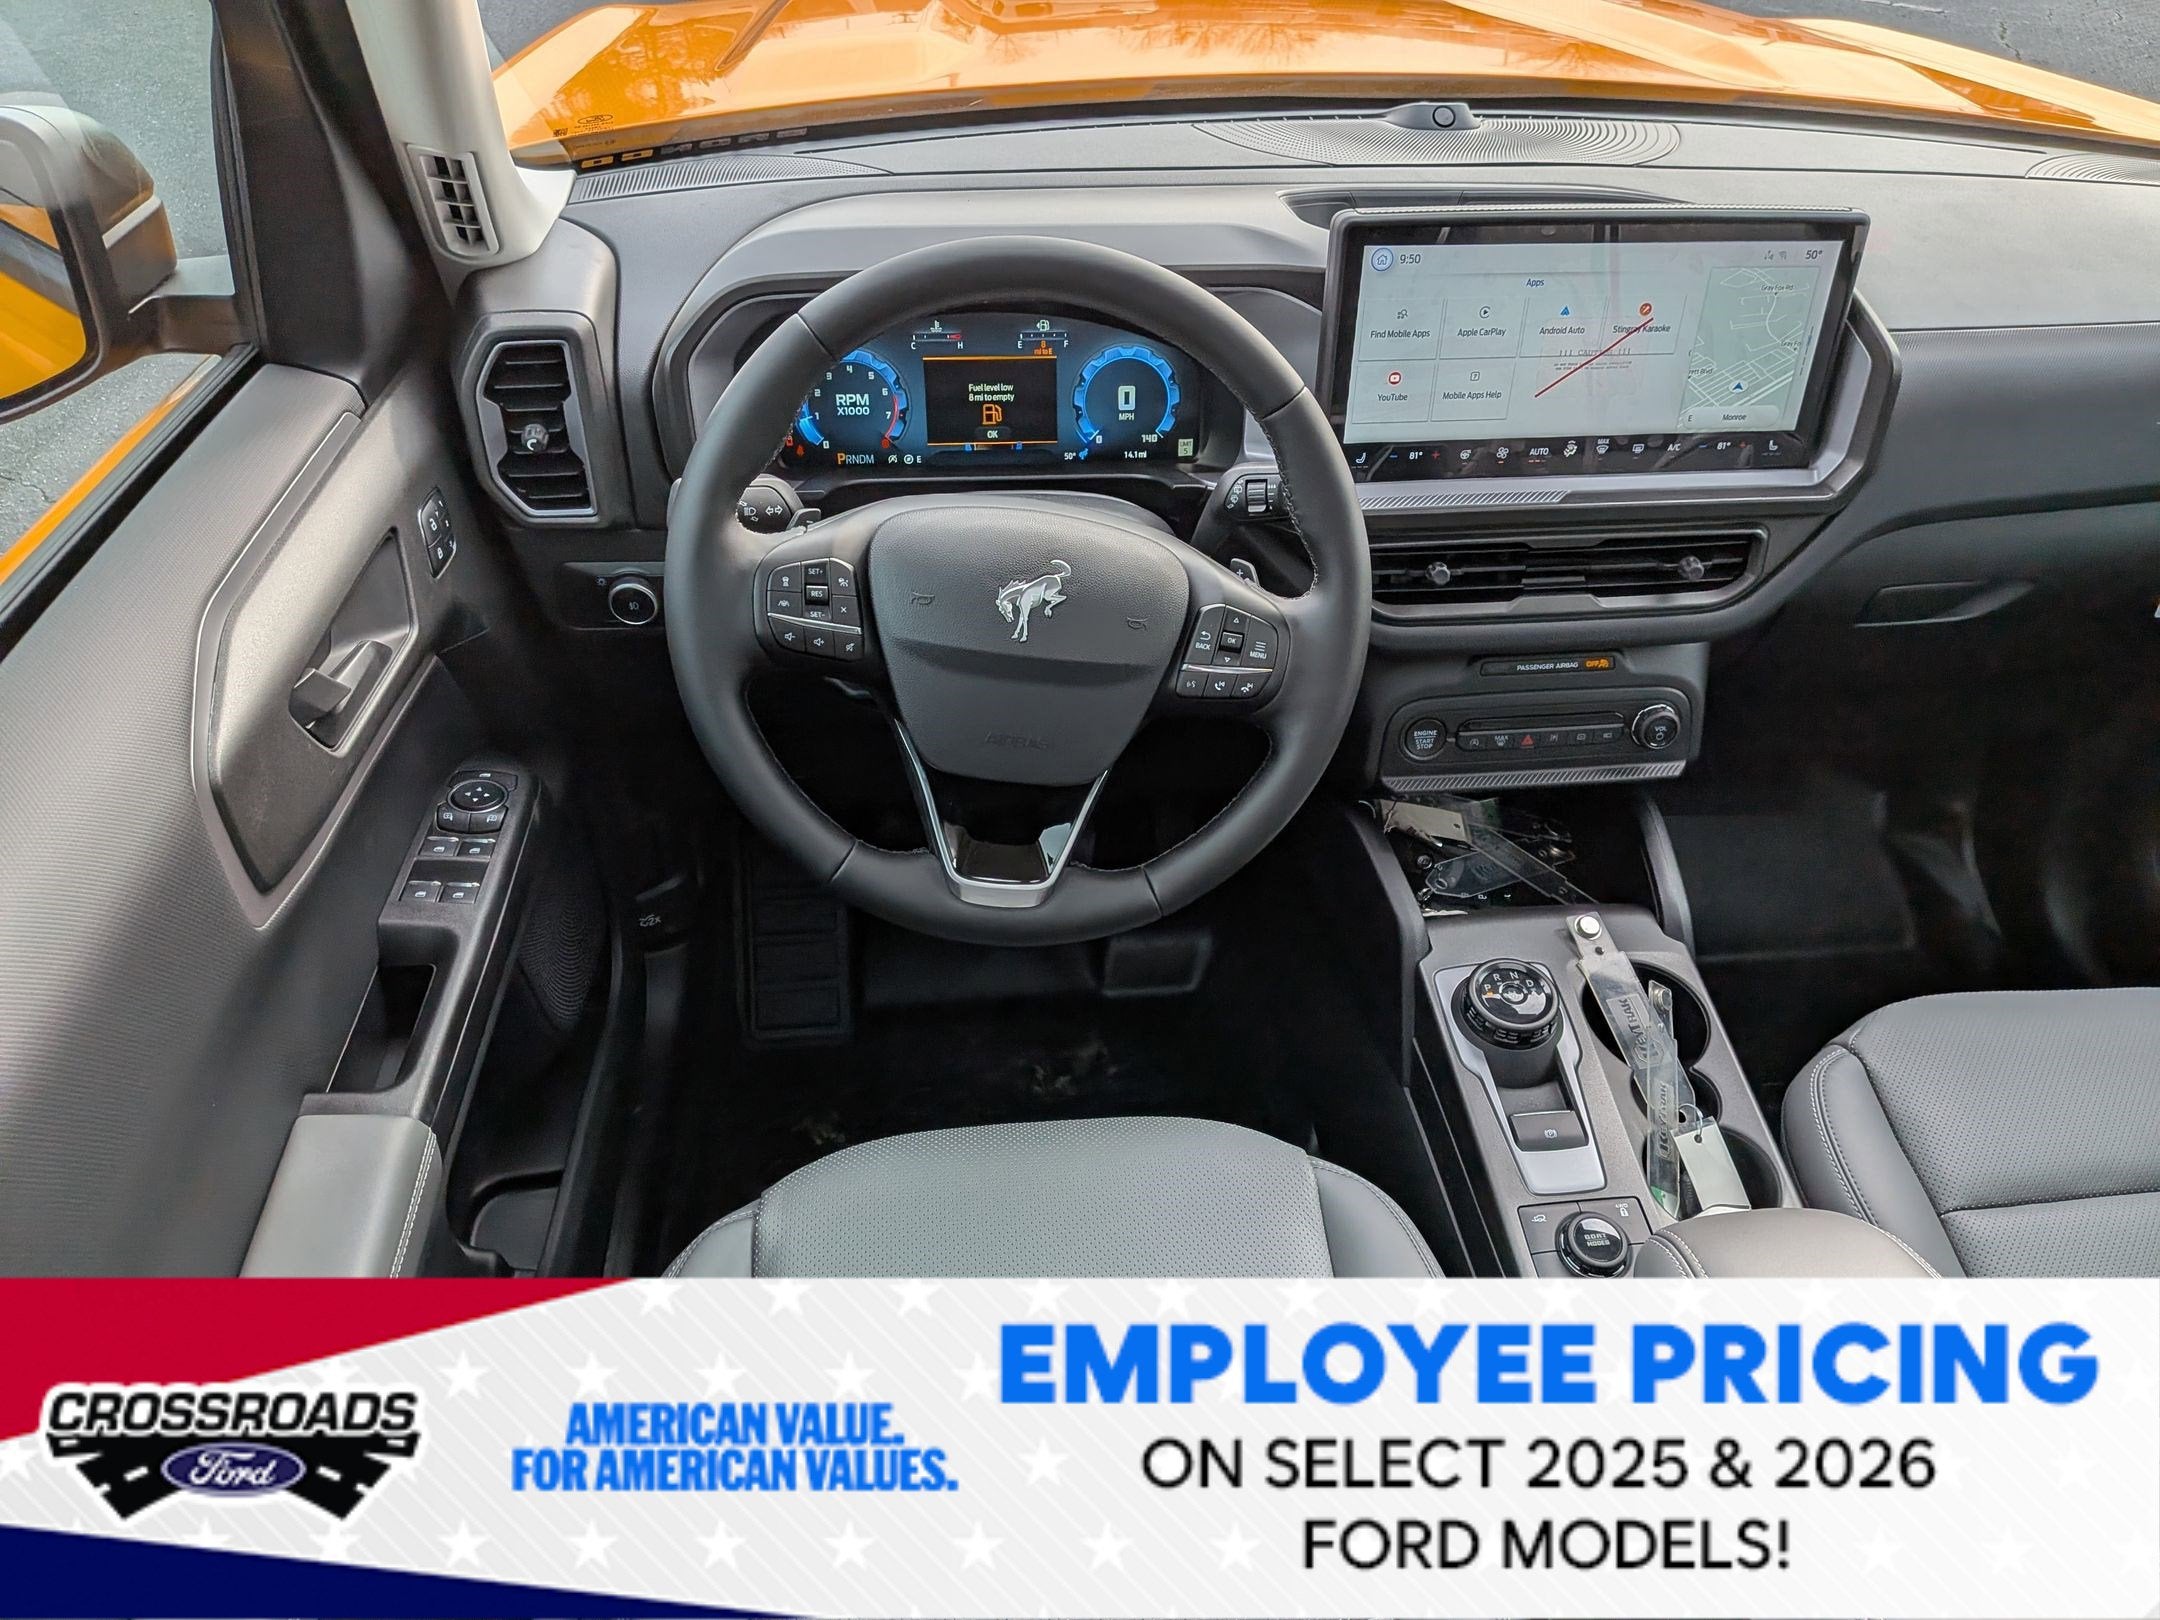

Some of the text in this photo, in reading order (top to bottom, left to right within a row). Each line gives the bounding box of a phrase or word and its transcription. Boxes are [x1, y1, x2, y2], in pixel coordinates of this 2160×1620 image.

[1399, 253, 1421, 264] 9:50
[1526, 278, 1545, 288] Apps
[1457, 327, 1507, 337] Apple CarPlay
[1539, 326, 1586, 335] Android Auto
[1642, 324, 1671, 333] Karaoke
[1370, 329, 1431, 338] Find Mobile Apps
[910, 342, 917, 350] C
[846, 365, 853, 373] 4
[868, 371, 875, 379] 5
[968, 382, 1014, 391] Fuel level low
[814, 389, 821, 397] 2
[882, 387, 889, 396] 6
[1442, 390, 1502, 400] Mobile Apps Help
[835, 393, 870, 406] RPM
[968, 393, 974, 401] 8
[992, 393, 1015, 402] empty
[1117, 385, 1136, 411] 0
[1377, 393, 1408, 401] YouTube
[836, 406, 870, 416] X1000
[885, 411, 892, 420] 7
[814, 412, 820, 420] 1
[1118, 412, 1135, 421] MPH
[986, 430, 999, 439] OK
[1141, 434, 1158, 443] 140
[1096, 435, 1103, 444] 0
[822, 440, 830, 449] 0
[1667, 443, 1681, 451] A/C
[1138, 450, 1147, 458] mi
[1529, 447, 1550, 456] AUTO
[811, 590, 823, 598] RES
[1195, 642, 1211, 651] BACK
[1249, 650, 1267, 660] MENU
[1516, 663, 1554, 671] PASSENGER
[1555, 661, 1579, 669] AIRBAG
[1493, 973, 1501, 981] R
[1510, 971, 1519, 979] N
[1526, 979, 1534, 987] D
[1484, 984, 1491, 992] P
